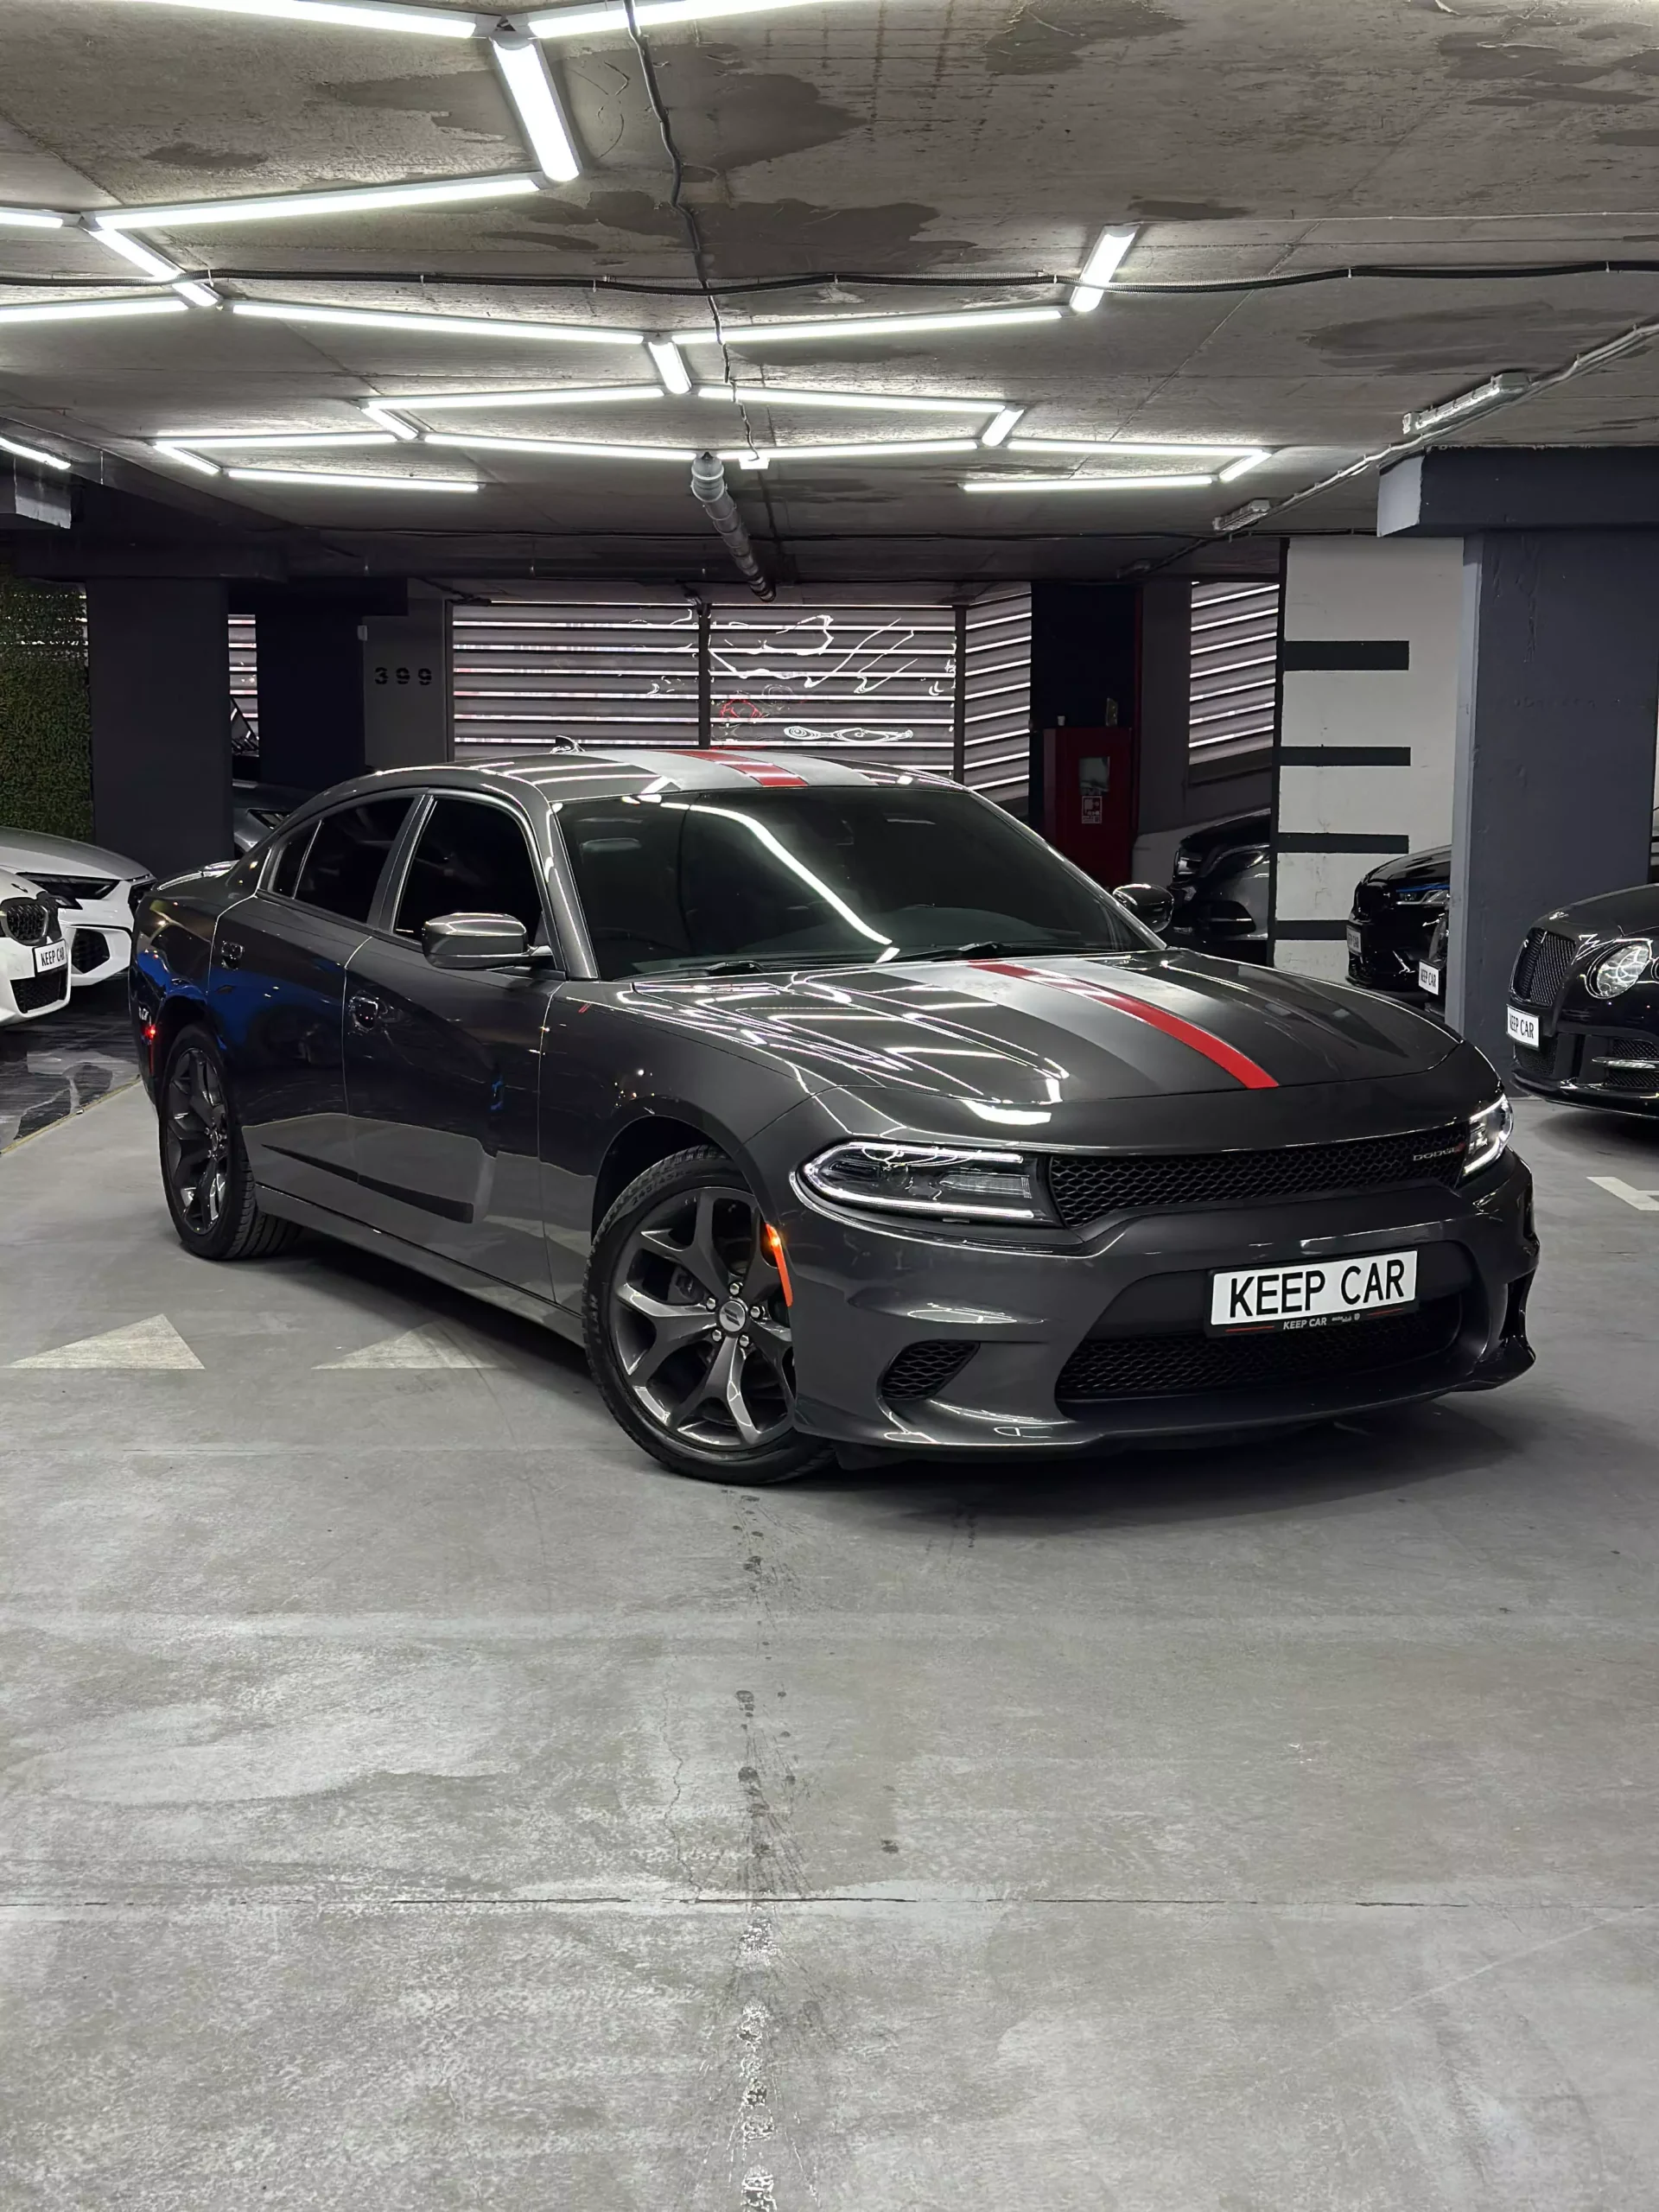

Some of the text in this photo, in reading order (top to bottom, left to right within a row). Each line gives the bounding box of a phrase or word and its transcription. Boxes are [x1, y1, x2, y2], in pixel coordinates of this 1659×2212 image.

[375, 667, 432, 685] 399
[41, 950, 55, 967] KEEP
[1520, 1019, 1535, 1039] CAR
[1230, 1259, 1405, 1319] KEEP CAR
[1282, 1319, 1307, 1331] KEEP
[1308, 1317, 1327, 1327] CAR
